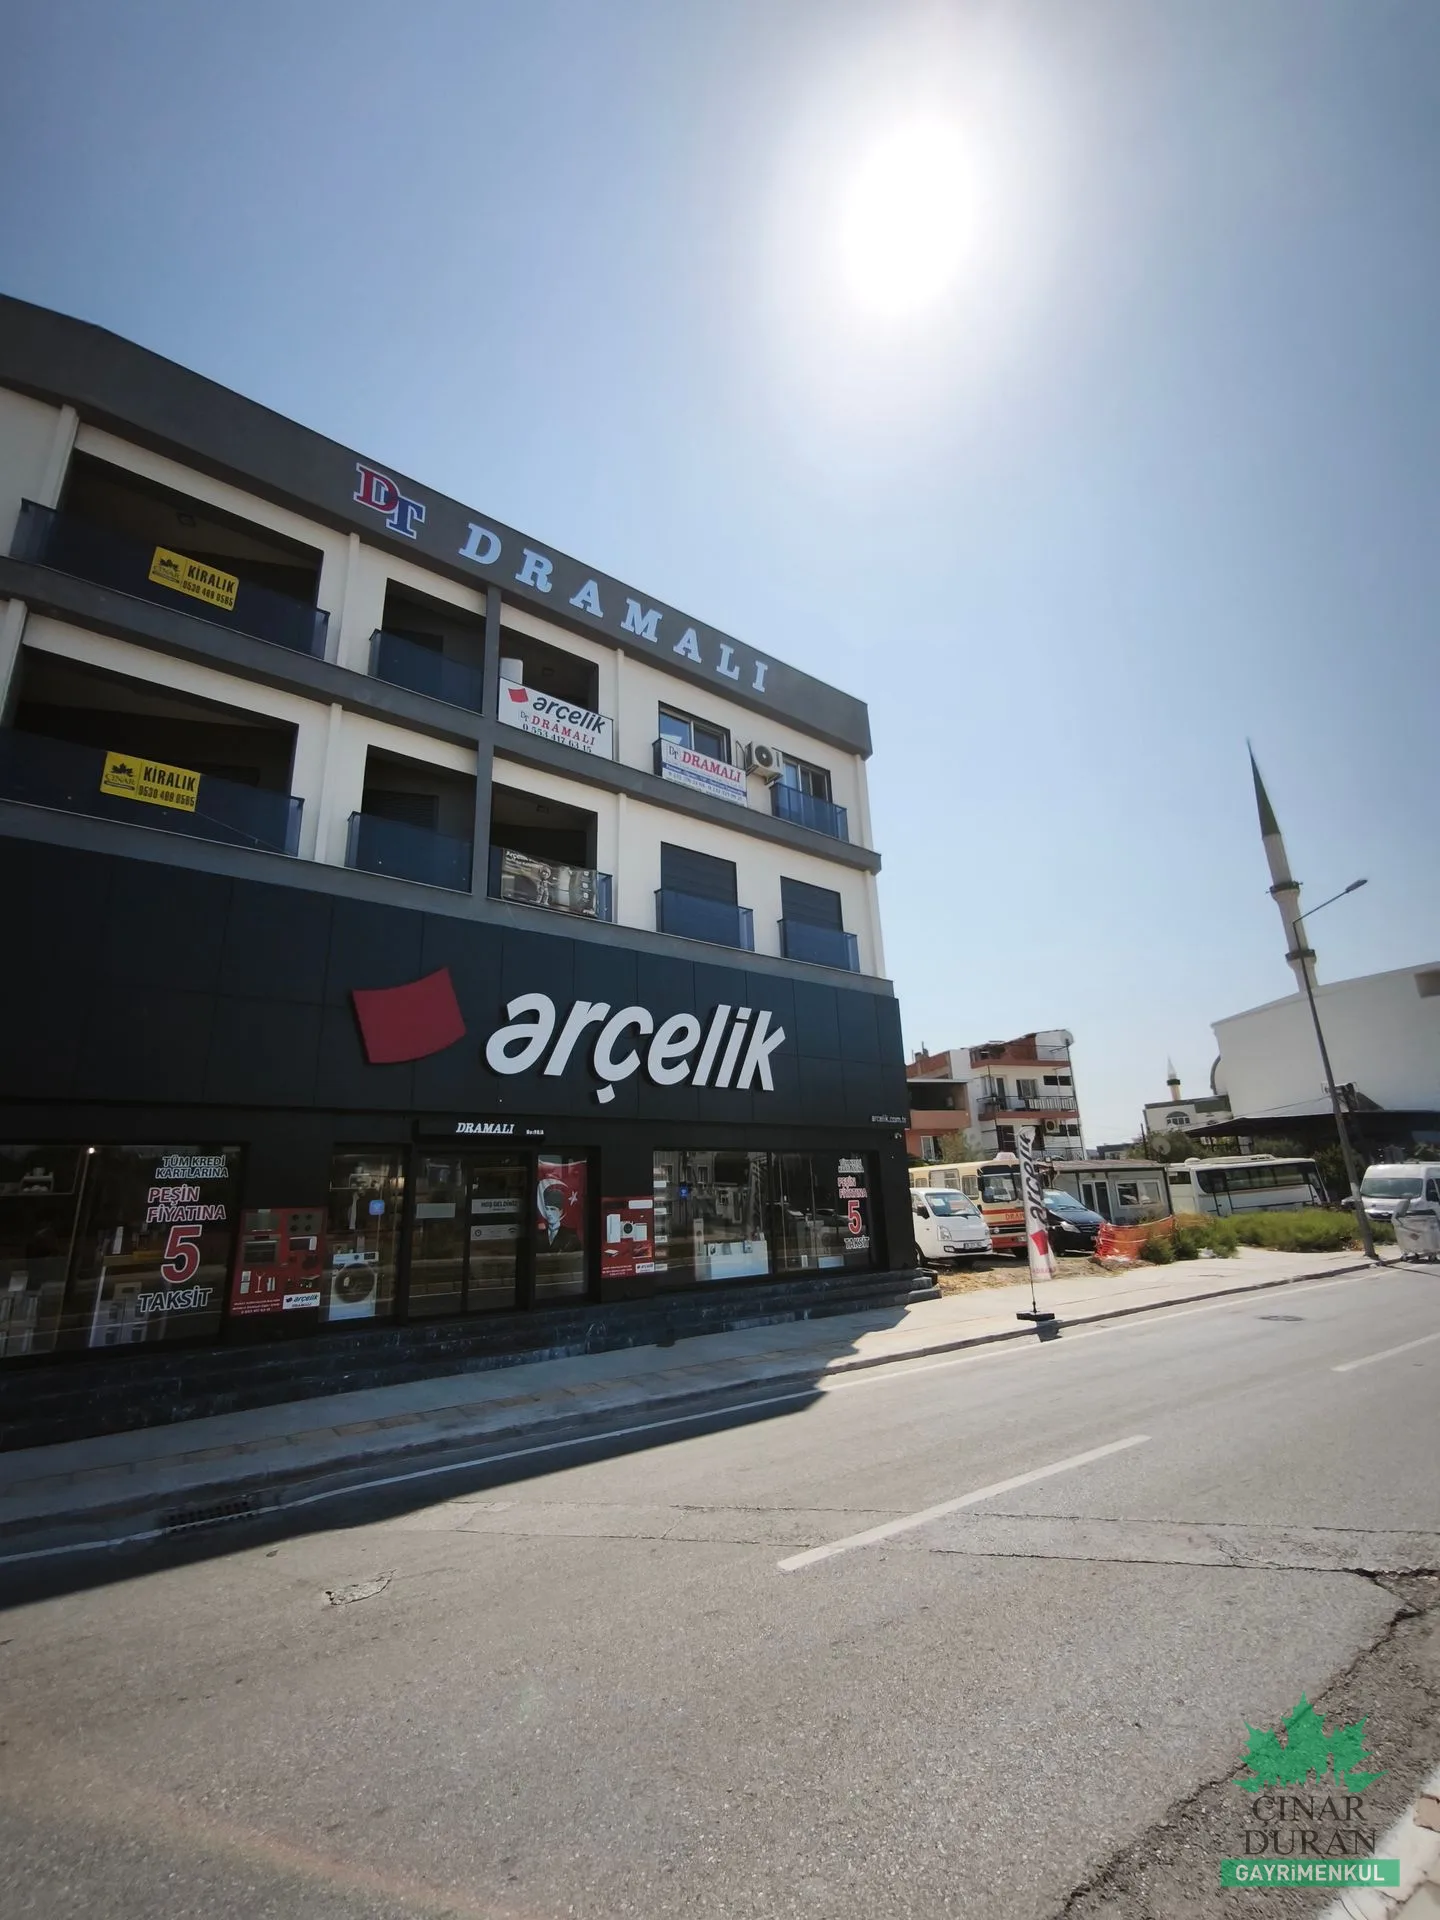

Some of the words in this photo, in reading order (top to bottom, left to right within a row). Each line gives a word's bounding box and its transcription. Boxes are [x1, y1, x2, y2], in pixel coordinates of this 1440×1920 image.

[187, 563, 236, 594] KİRALIK
[353, 462, 426, 540] DT
[458, 522, 769, 693] DRAMALI
[531, 715, 596, 746] DRAMALI
[532, 696, 606, 734] arçelik
[143, 764, 196, 792] KİRALIK
[682, 751, 742, 783] DRAMALI
[486, 992, 787, 1104] arçelik
[455, 1122, 515, 1134] DRAMALI
[155, 1167, 228, 1179] KARTLARINA
[162, 1154, 190, 1168] TÜM
[191, 1154, 226, 1167] KREDİ
[147, 1183, 200, 1206] PEŞİN
[146, 1203, 227, 1223] FİYATINA
[847, 1199, 862, 1235] 5
[160, 1224, 202, 1284] 5
[137, 1285, 213, 1313] TAKSİT
